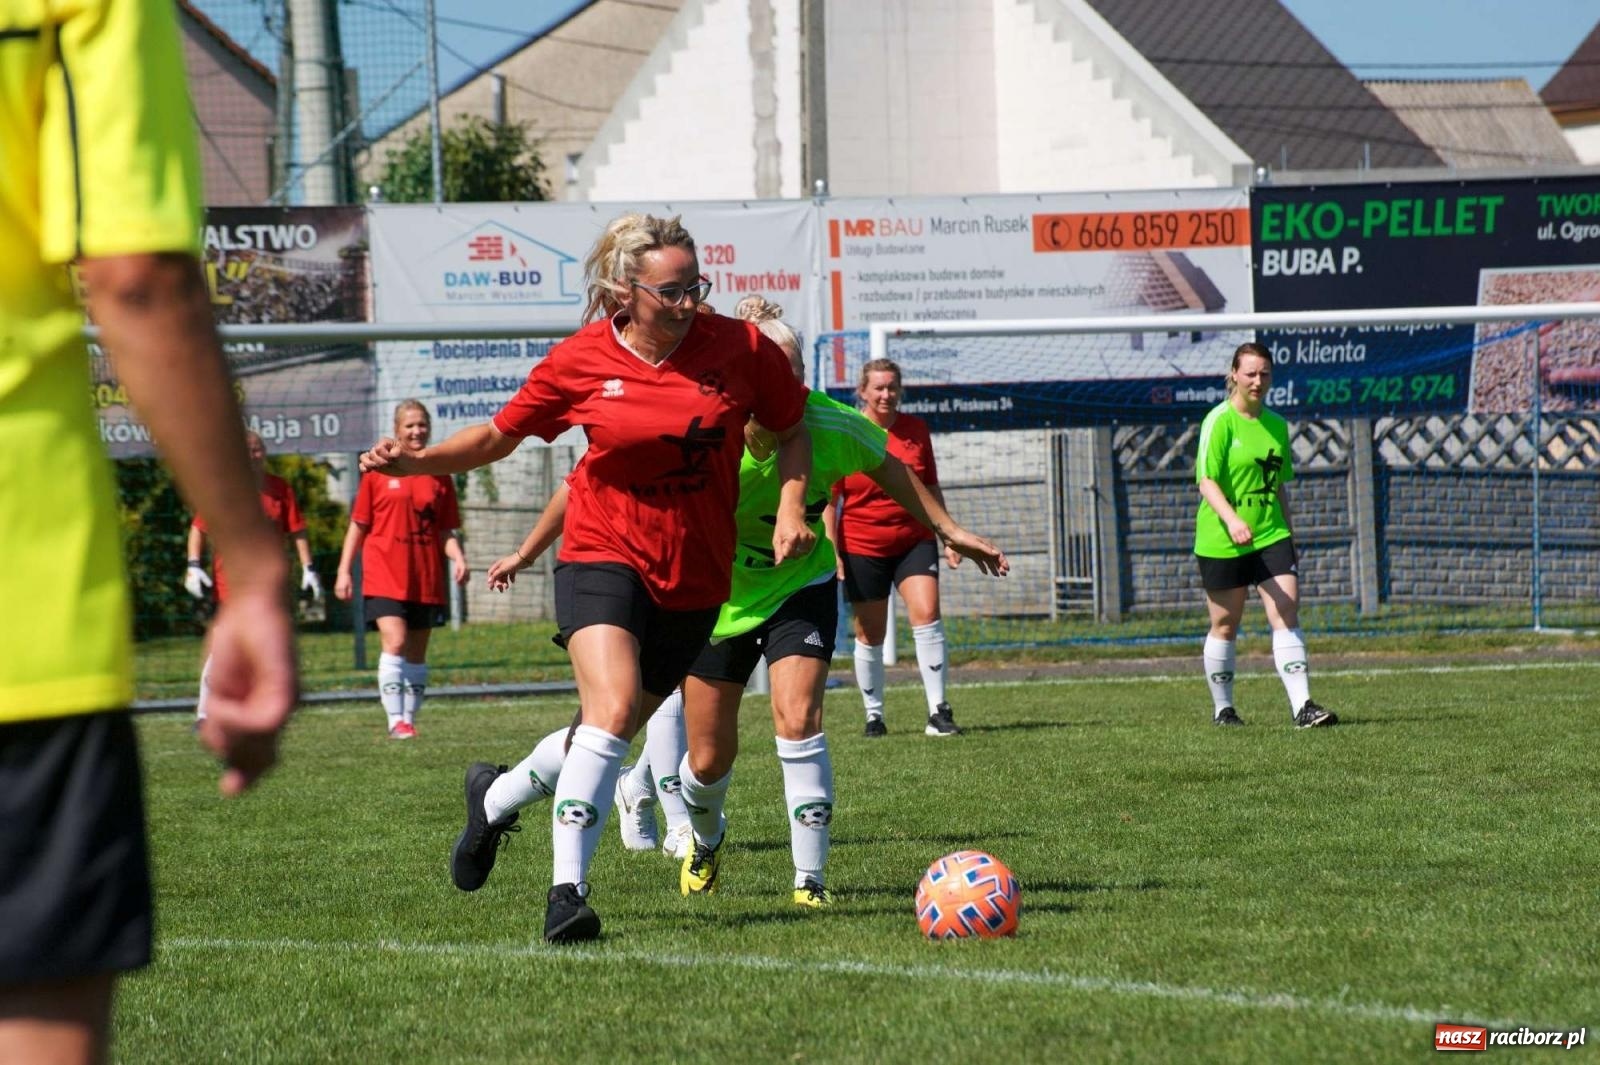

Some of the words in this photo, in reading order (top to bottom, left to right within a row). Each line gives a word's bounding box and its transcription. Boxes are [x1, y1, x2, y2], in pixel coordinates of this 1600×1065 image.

[844, 219, 875, 237] MR
[879, 218, 924, 236] BAU
[930, 216, 979, 236] Marcin
[985, 214, 1030, 234] Rusek
[1078, 216, 1124, 249] 666
[1133, 214, 1178, 247] 859
[1188, 212, 1236, 245] 250
[1261, 196, 1504, 241] EKO-PELLET
[201, 224, 318, 250] ALSTWO
[1537, 221, 1557, 241] ul.
[1560, 221, 1600, 242] Ogro
[704, 244, 736, 265] 320
[1261, 247, 1336, 277] BUBA
[1341, 246, 1364, 275] P.
[444, 271, 542, 287] DAW-BUD
[725, 269, 802, 293] Tworków
[970, 265, 1005, 280] domów
[1296, 340, 1367, 364] klienta
[1306, 378, 1351, 405] 785
[1359, 376, 1404, 403] 742
[1411, 373, 1456, 399] 974
[309, 413, 340, 437] 10
